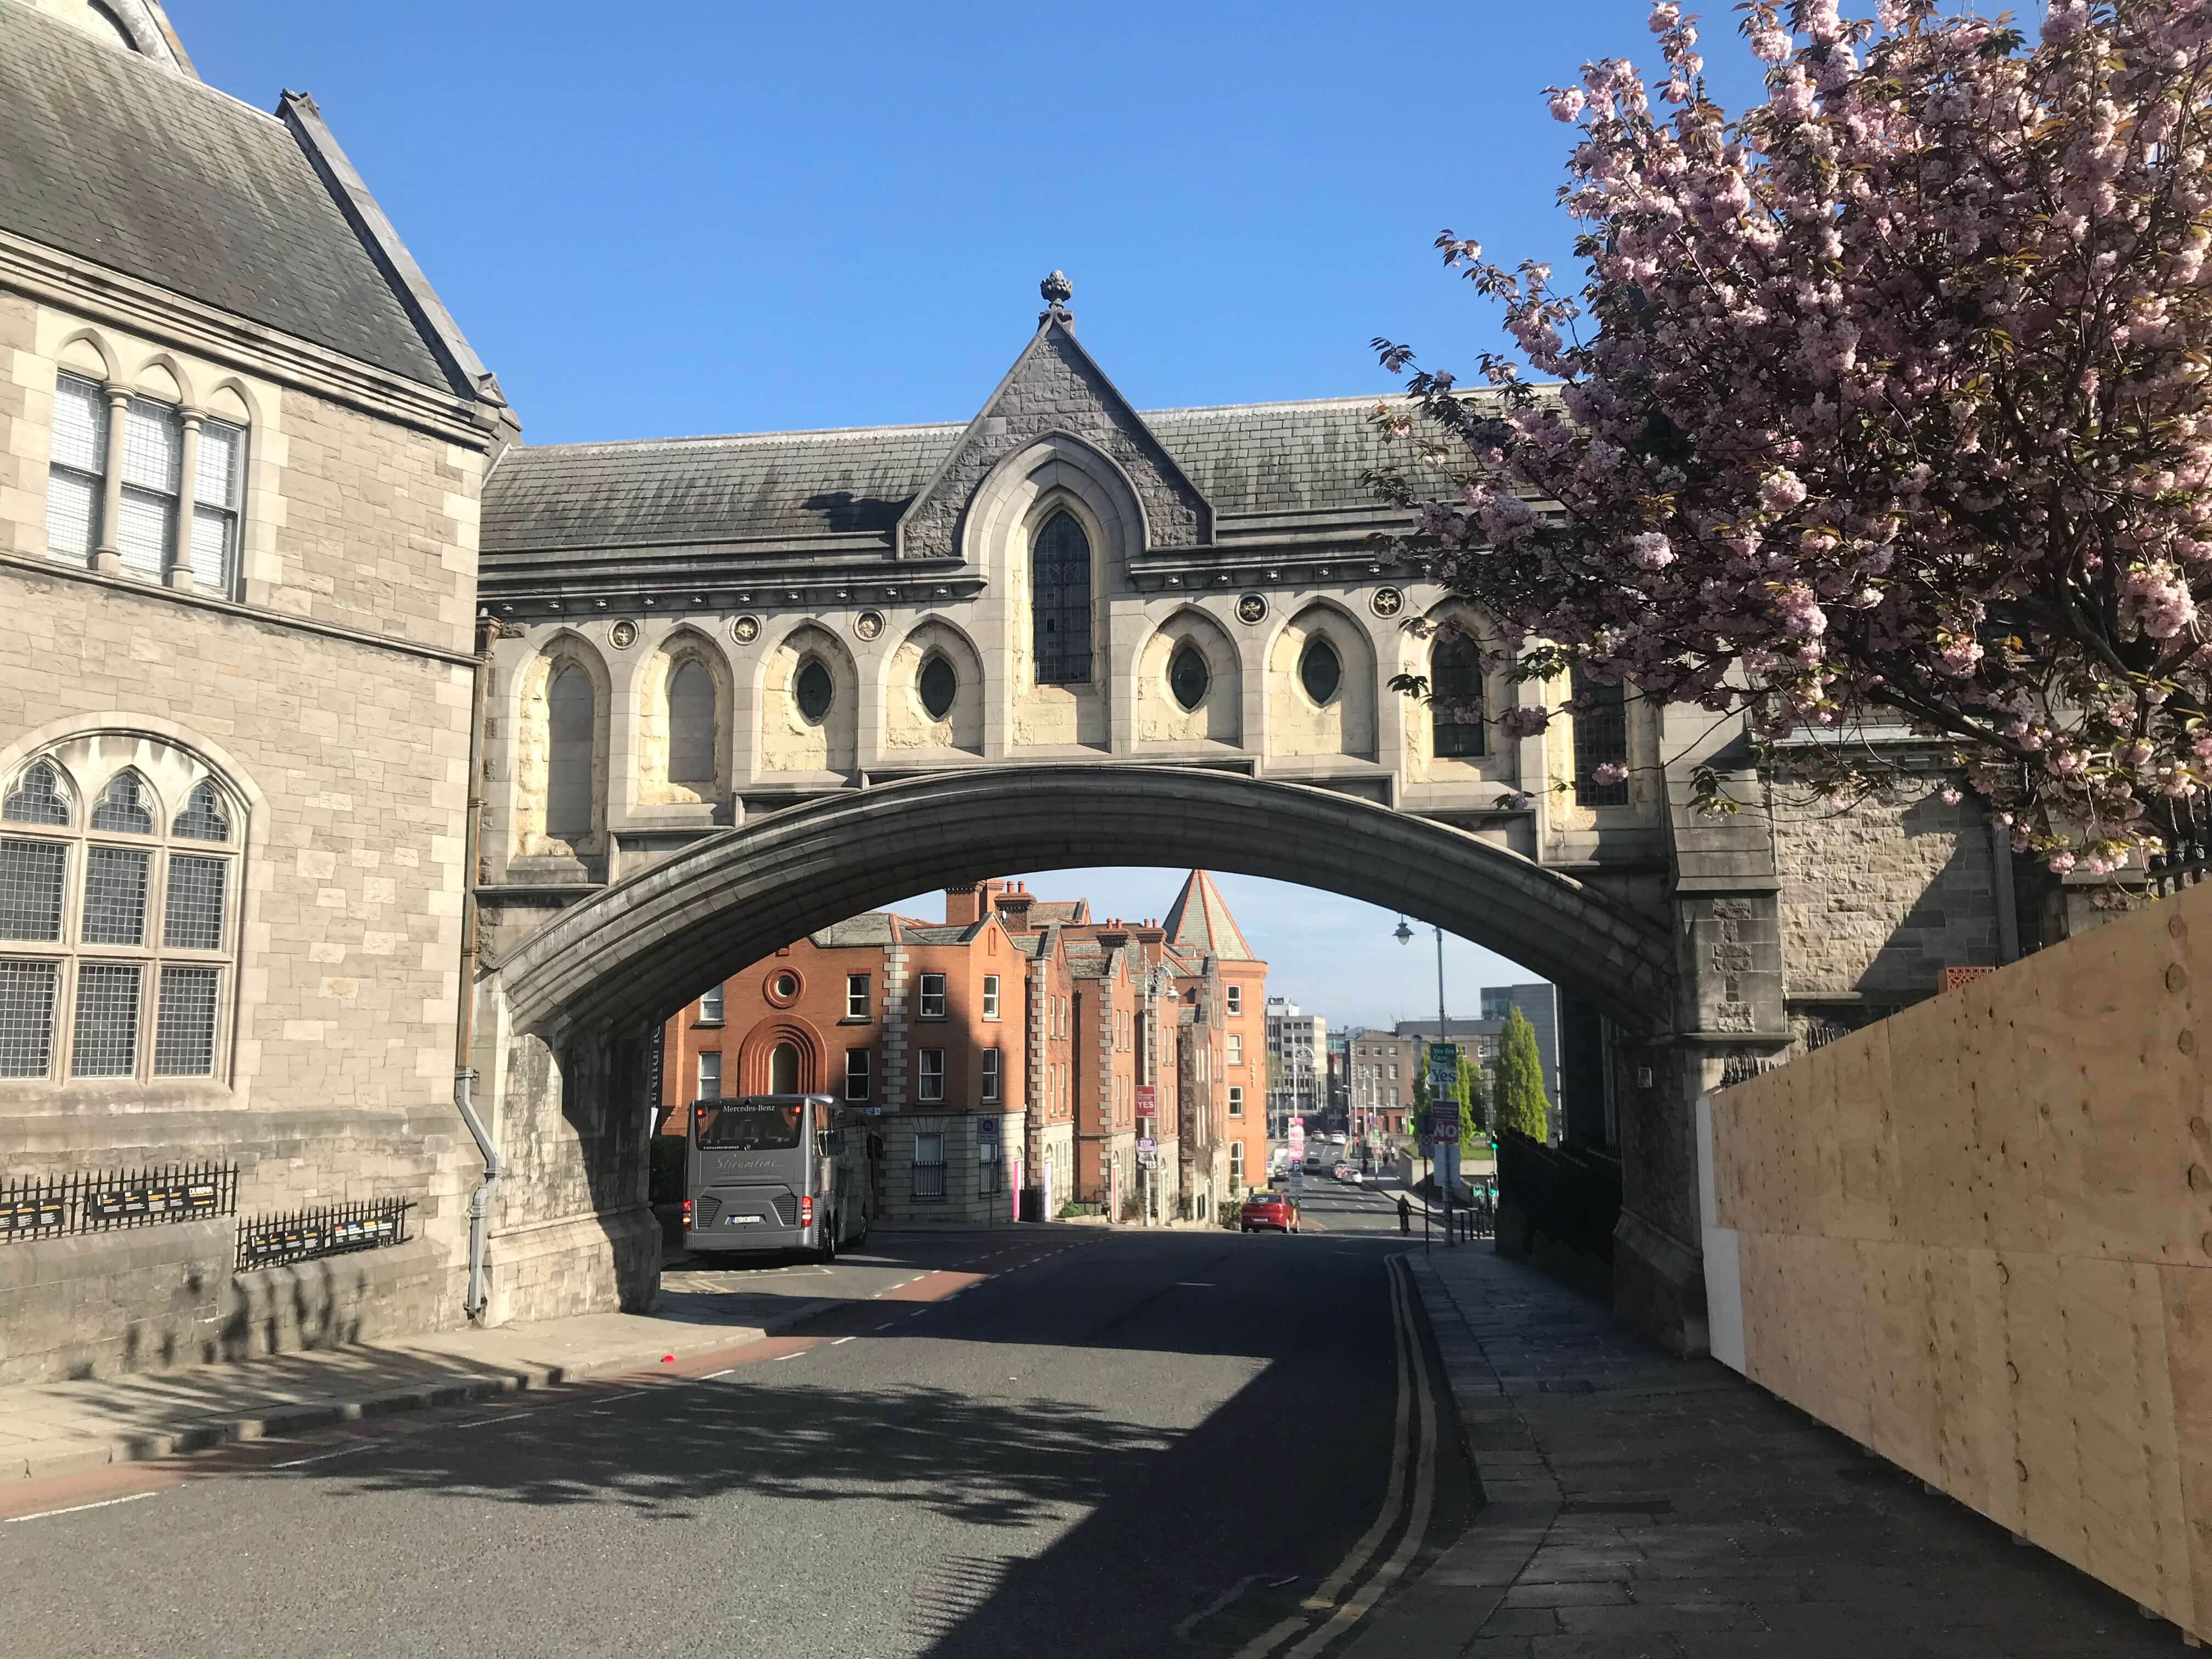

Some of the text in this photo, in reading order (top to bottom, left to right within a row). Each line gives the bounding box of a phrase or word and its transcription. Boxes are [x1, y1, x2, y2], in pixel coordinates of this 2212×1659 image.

[1431, 1069, 1457, 1082] Yes
[723, 1104, 776, 1113] Mercedes-Benz
[1434, 1123, 1458, 1138] NO
[713, 1154, 781, 1169] Streamline
[1146, 1160, 1156, 1169] YES
